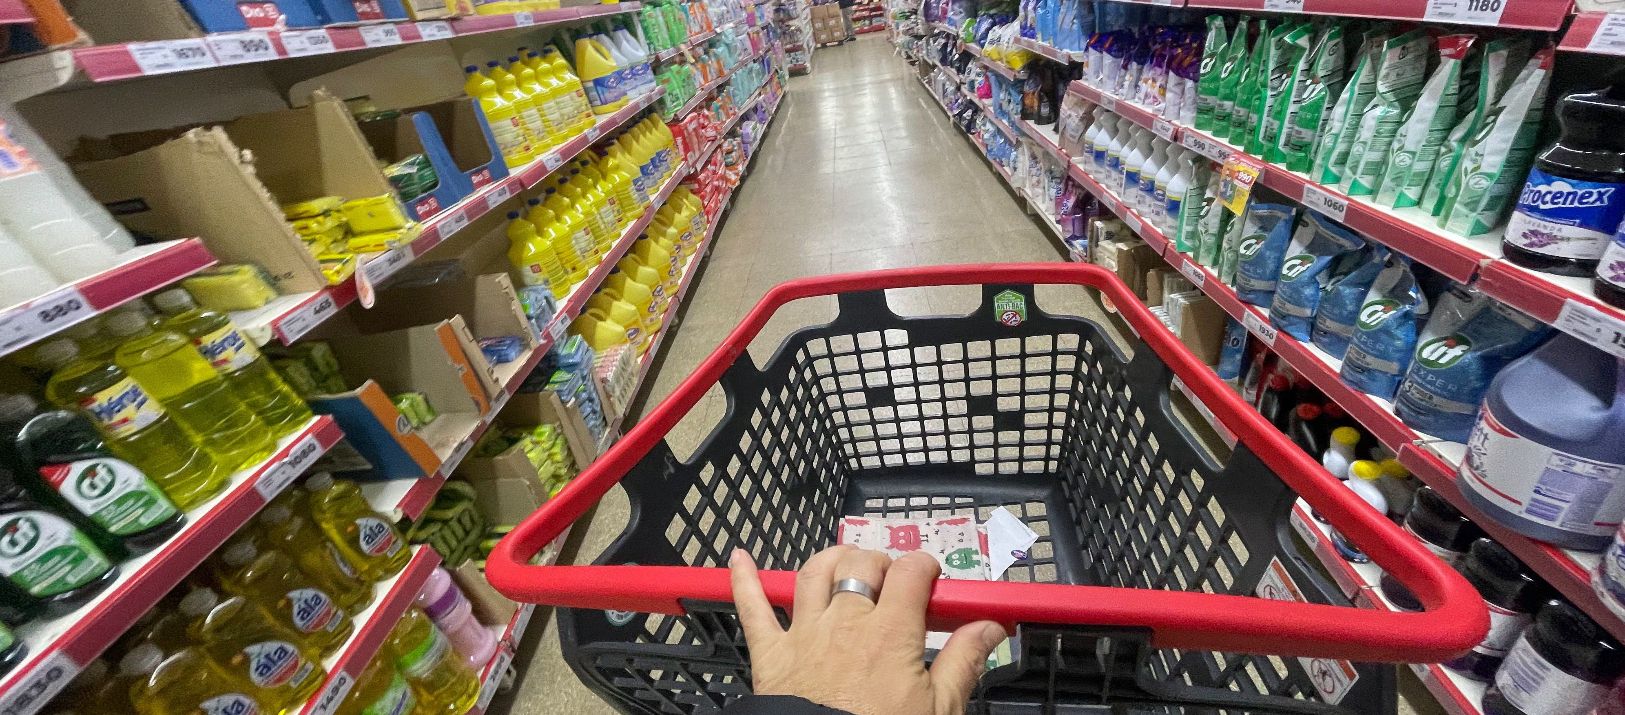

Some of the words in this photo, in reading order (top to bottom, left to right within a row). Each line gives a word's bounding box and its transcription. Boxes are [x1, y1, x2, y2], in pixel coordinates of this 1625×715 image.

[1467, 0, 1501, 12] 1180
[1323, 197, 1345, 213] 1060
[1421, 340, 1471, 364] Cif
[1412, 362, 1460, 393] EXPER
[287, 442, 317, 469] 1080
[80, 462, 114, 498] Cif
[0, 517, 38, 555] Cif
